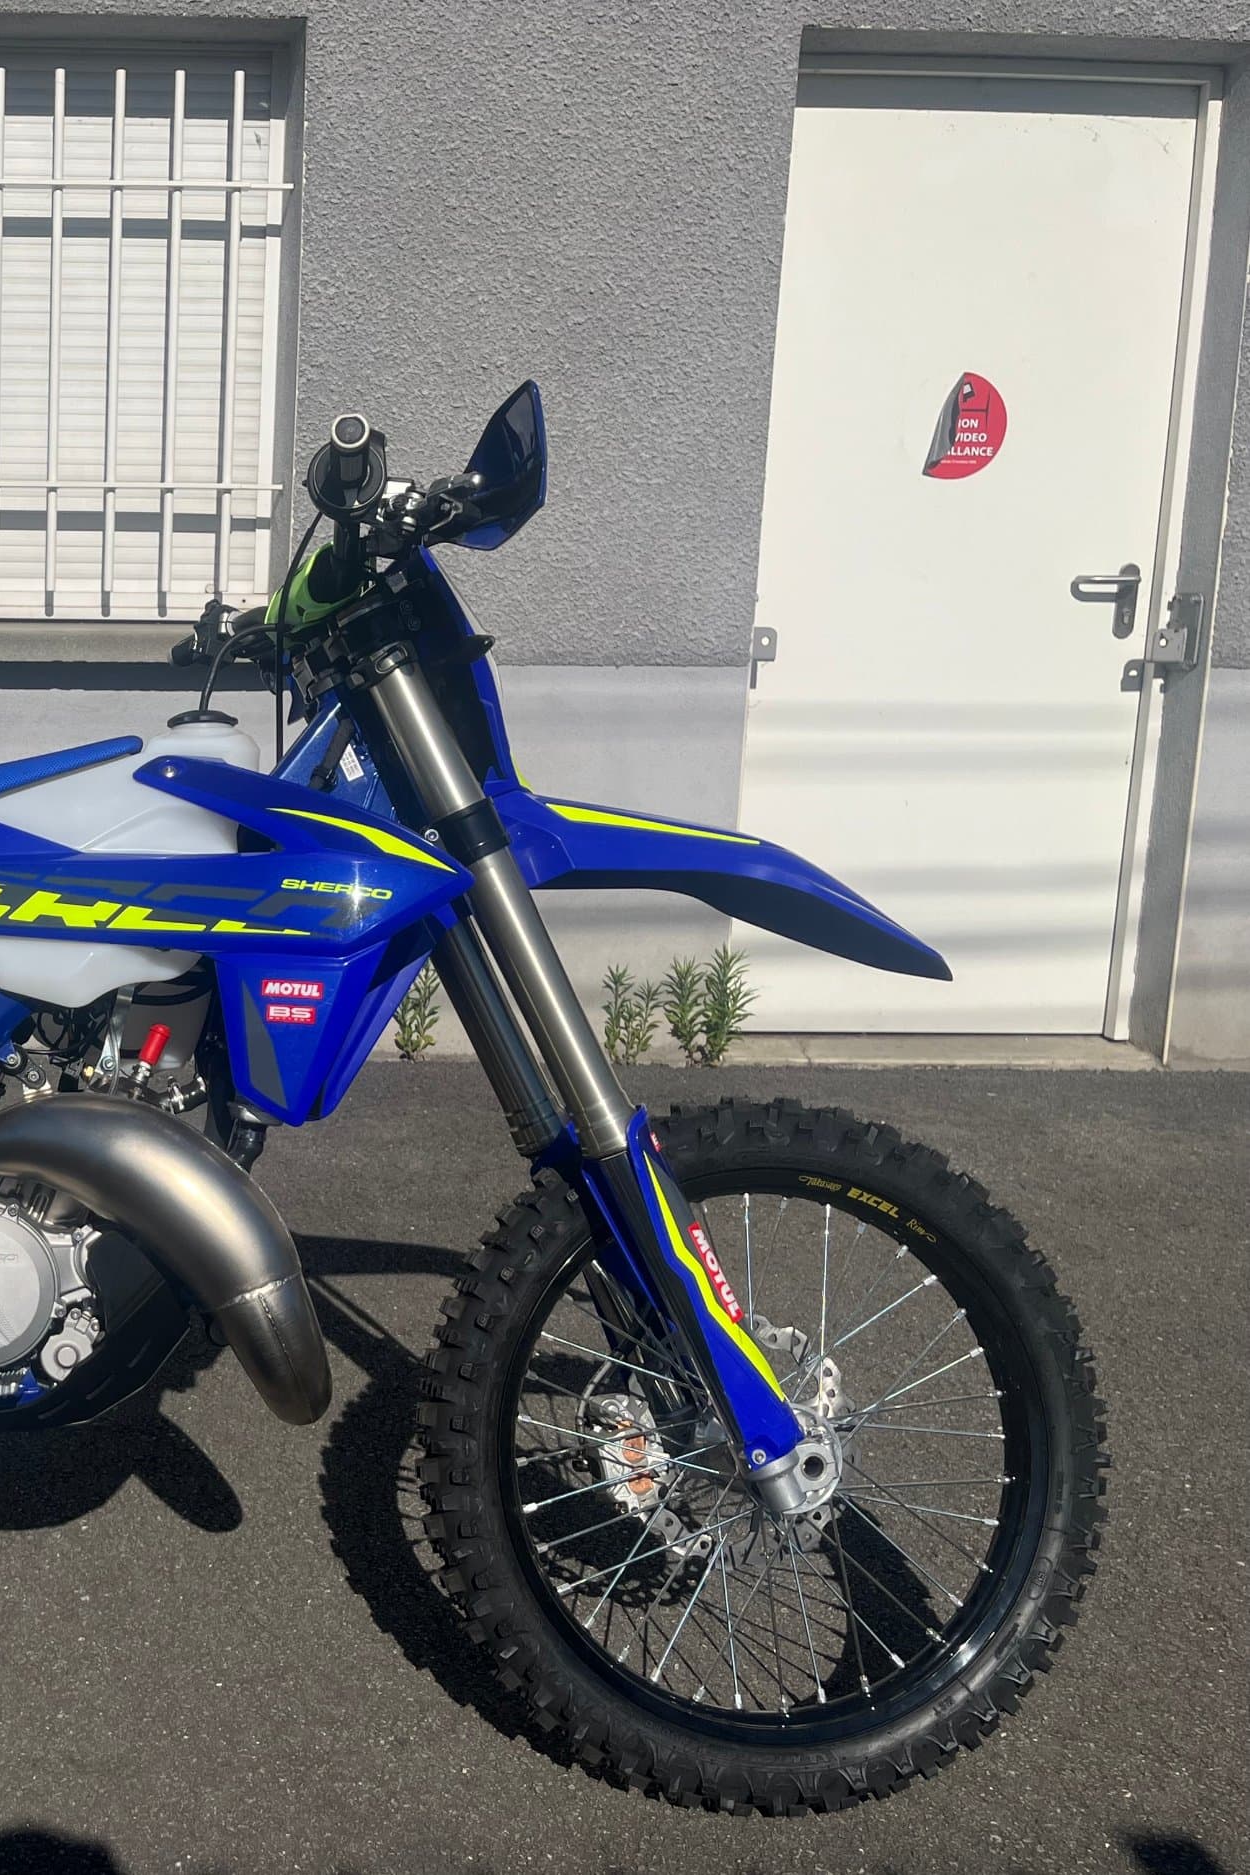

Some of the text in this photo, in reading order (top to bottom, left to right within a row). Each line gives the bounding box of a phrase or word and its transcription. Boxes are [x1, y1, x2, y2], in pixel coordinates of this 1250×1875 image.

[281, 878, 393, 900] SHERCO
[265, 982, 320, 997] MOTUL
[269, 1006, 311, 1018] BS
[846, 1187, 899, 1218] EXCEL
[692, 1228, 741, 1318] MOTUL
